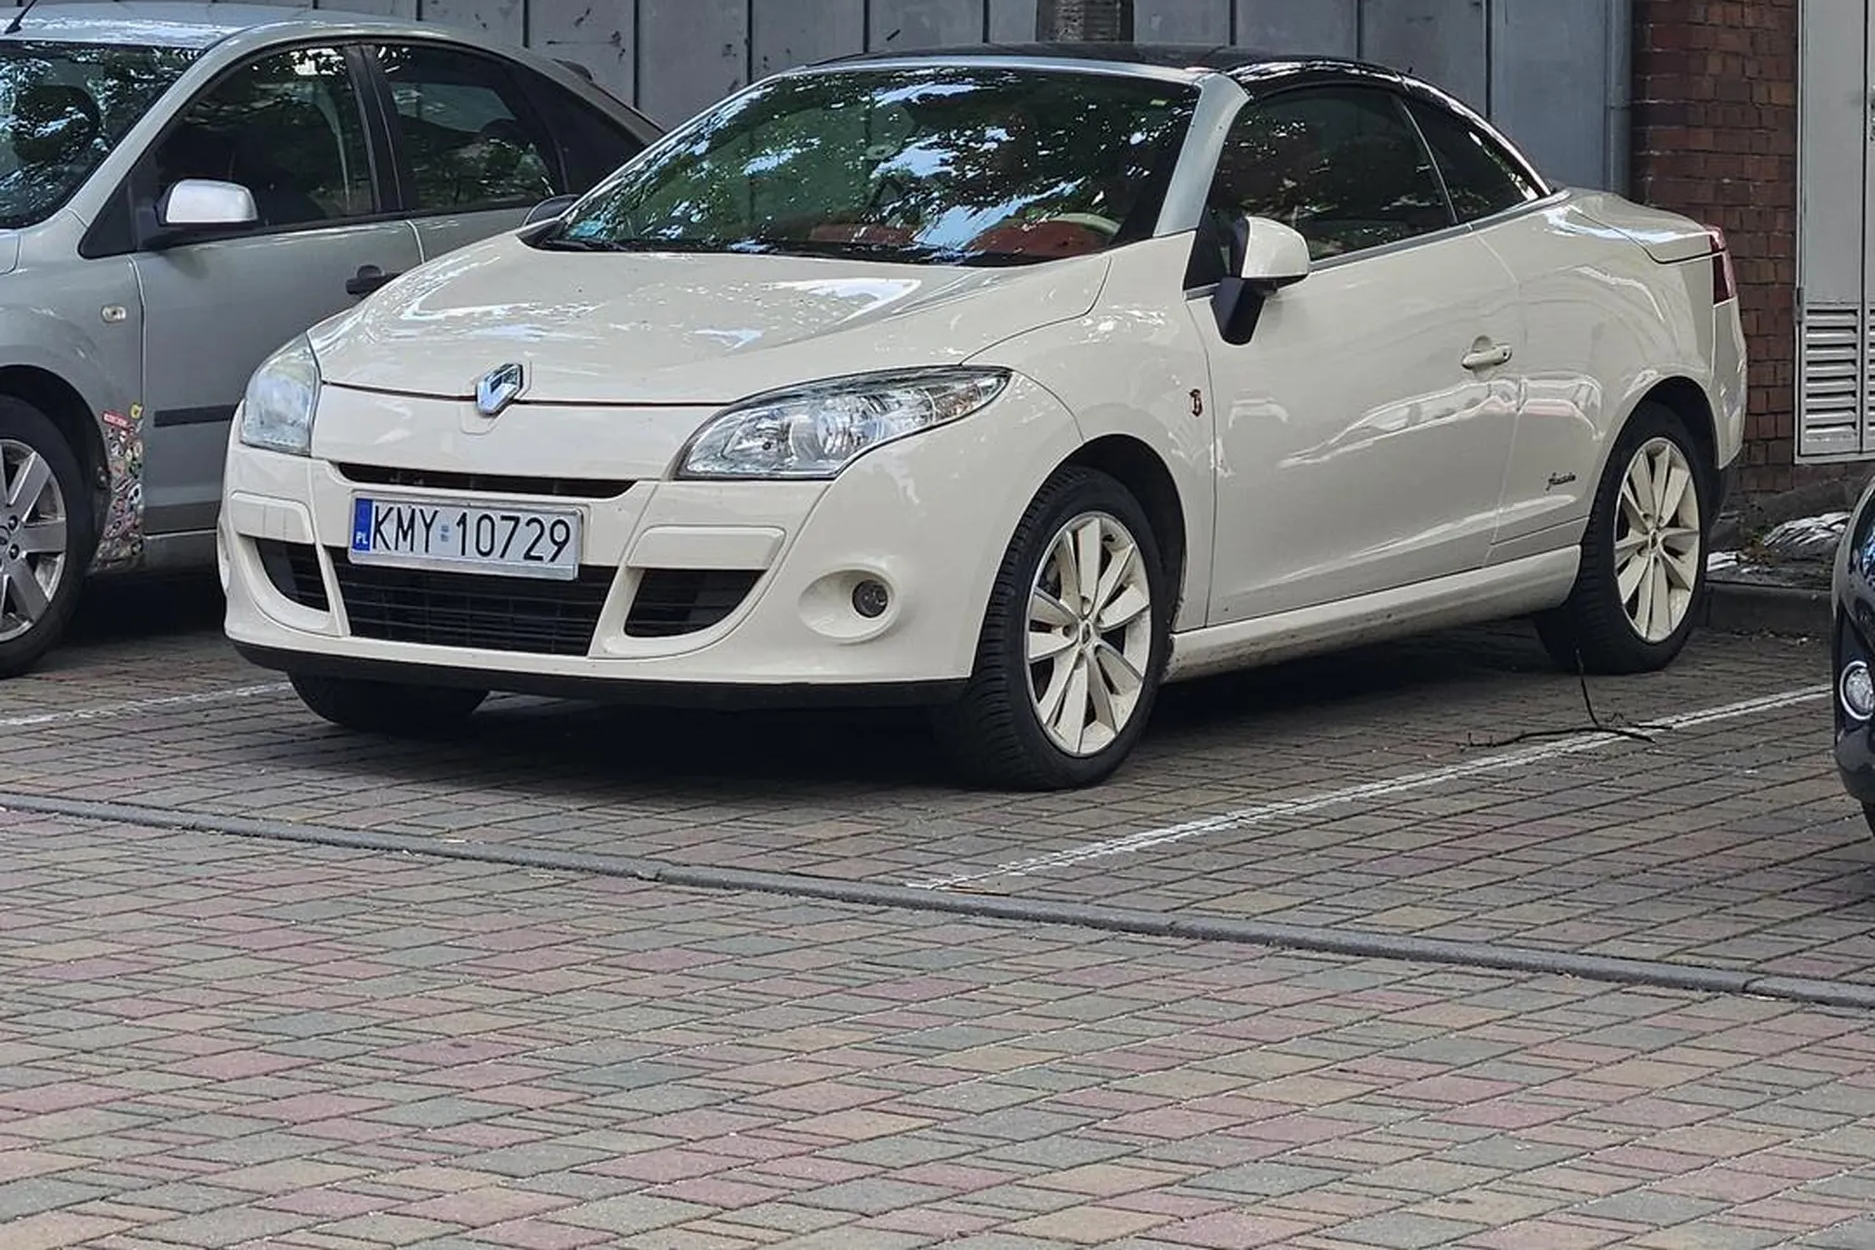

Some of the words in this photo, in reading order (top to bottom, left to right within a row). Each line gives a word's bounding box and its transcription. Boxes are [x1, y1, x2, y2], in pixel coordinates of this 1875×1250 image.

[356, 531, 368, 544] PL
[372, 505, 439, 553] KMY
[456, 511, 571, 563] 10729
